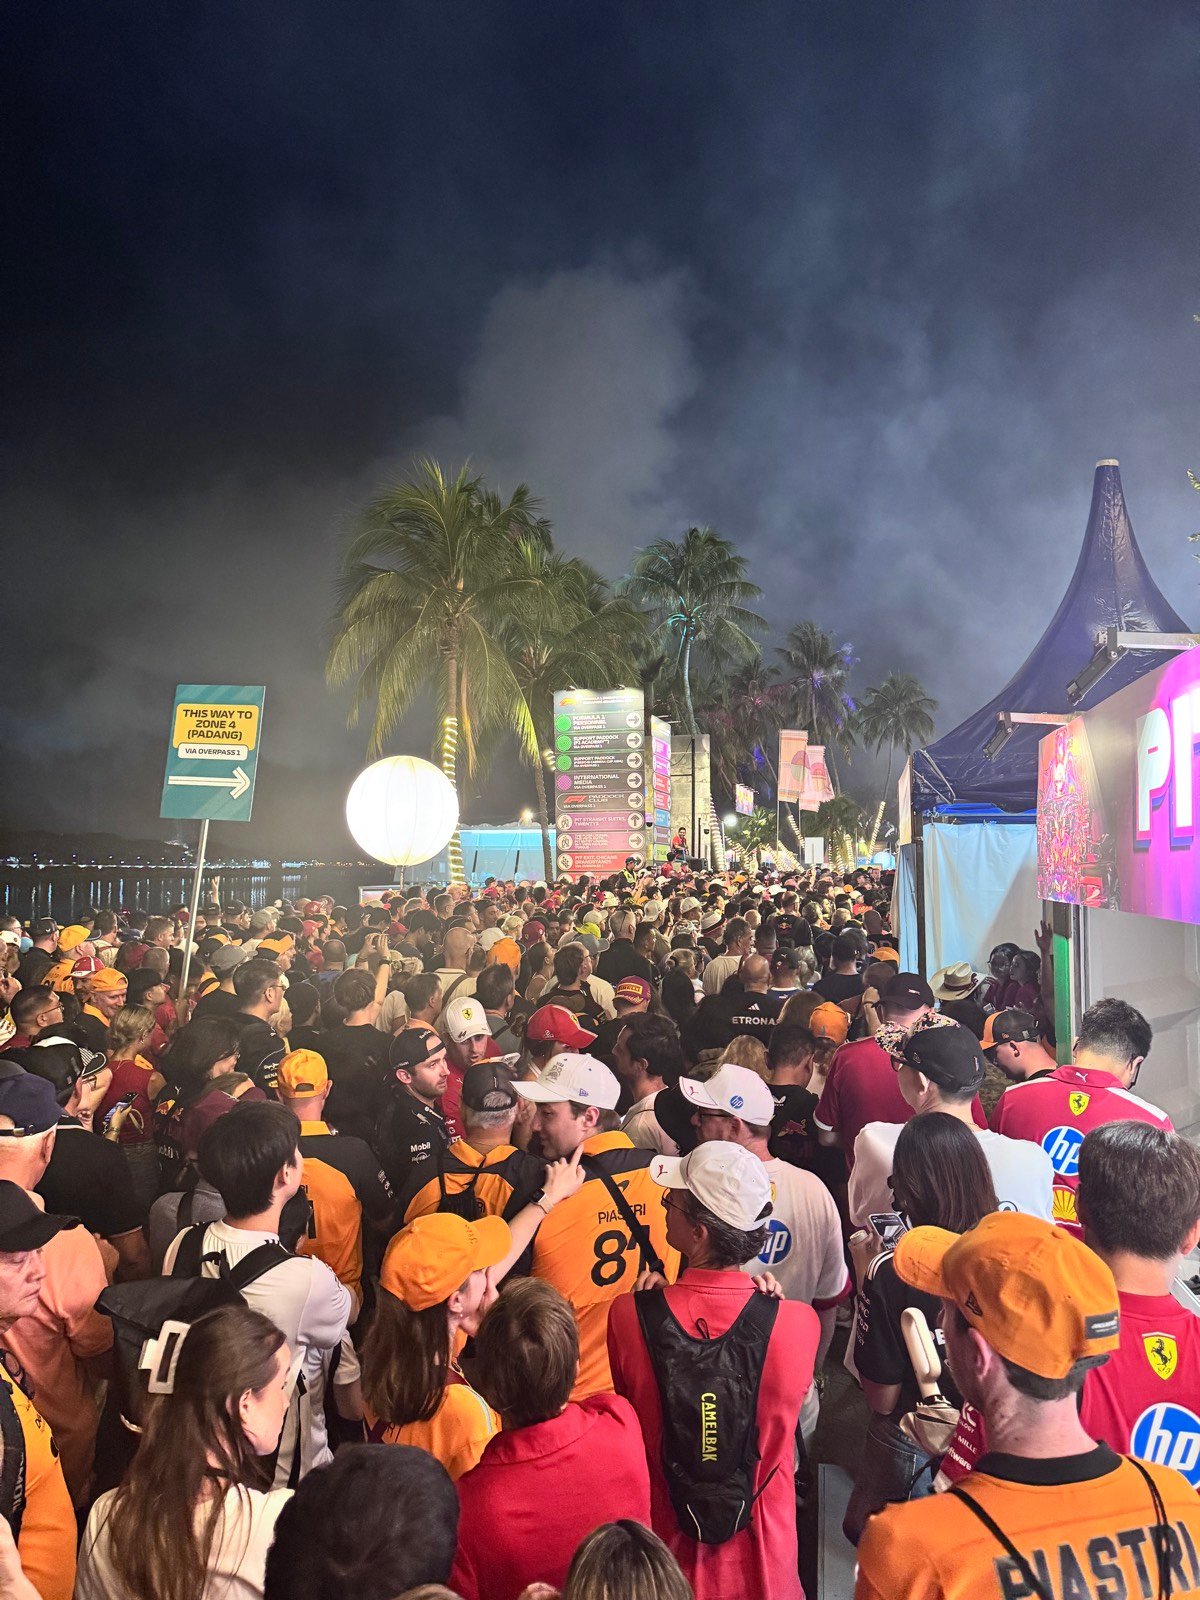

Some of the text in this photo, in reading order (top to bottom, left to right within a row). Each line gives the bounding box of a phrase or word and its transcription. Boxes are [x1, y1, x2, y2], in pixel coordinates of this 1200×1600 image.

[182, 709, 253, 720] THIS WAY TO
[196, 720, 236, 729] ZONE 4
[187, 730, 242, 741] (PADANG)
[1134, 686, 1200, 840] PI
[732, 1016, 777, 1025] ETRONA
[730, 1096, 744, 1109] hp
[410, 1142, 431, 1152] Mobil
[1048, 1128, 1081, 1173] hp
[598, 1204, 646, 1224] PIARI
[702, 1392, 718, 1462] CAMELBAK
[958, 1436, 978, 1454] MILLE
[1143, 1404, 1200, 1470] hp
[993, 1521, 1200, 1600] PIASTRI
